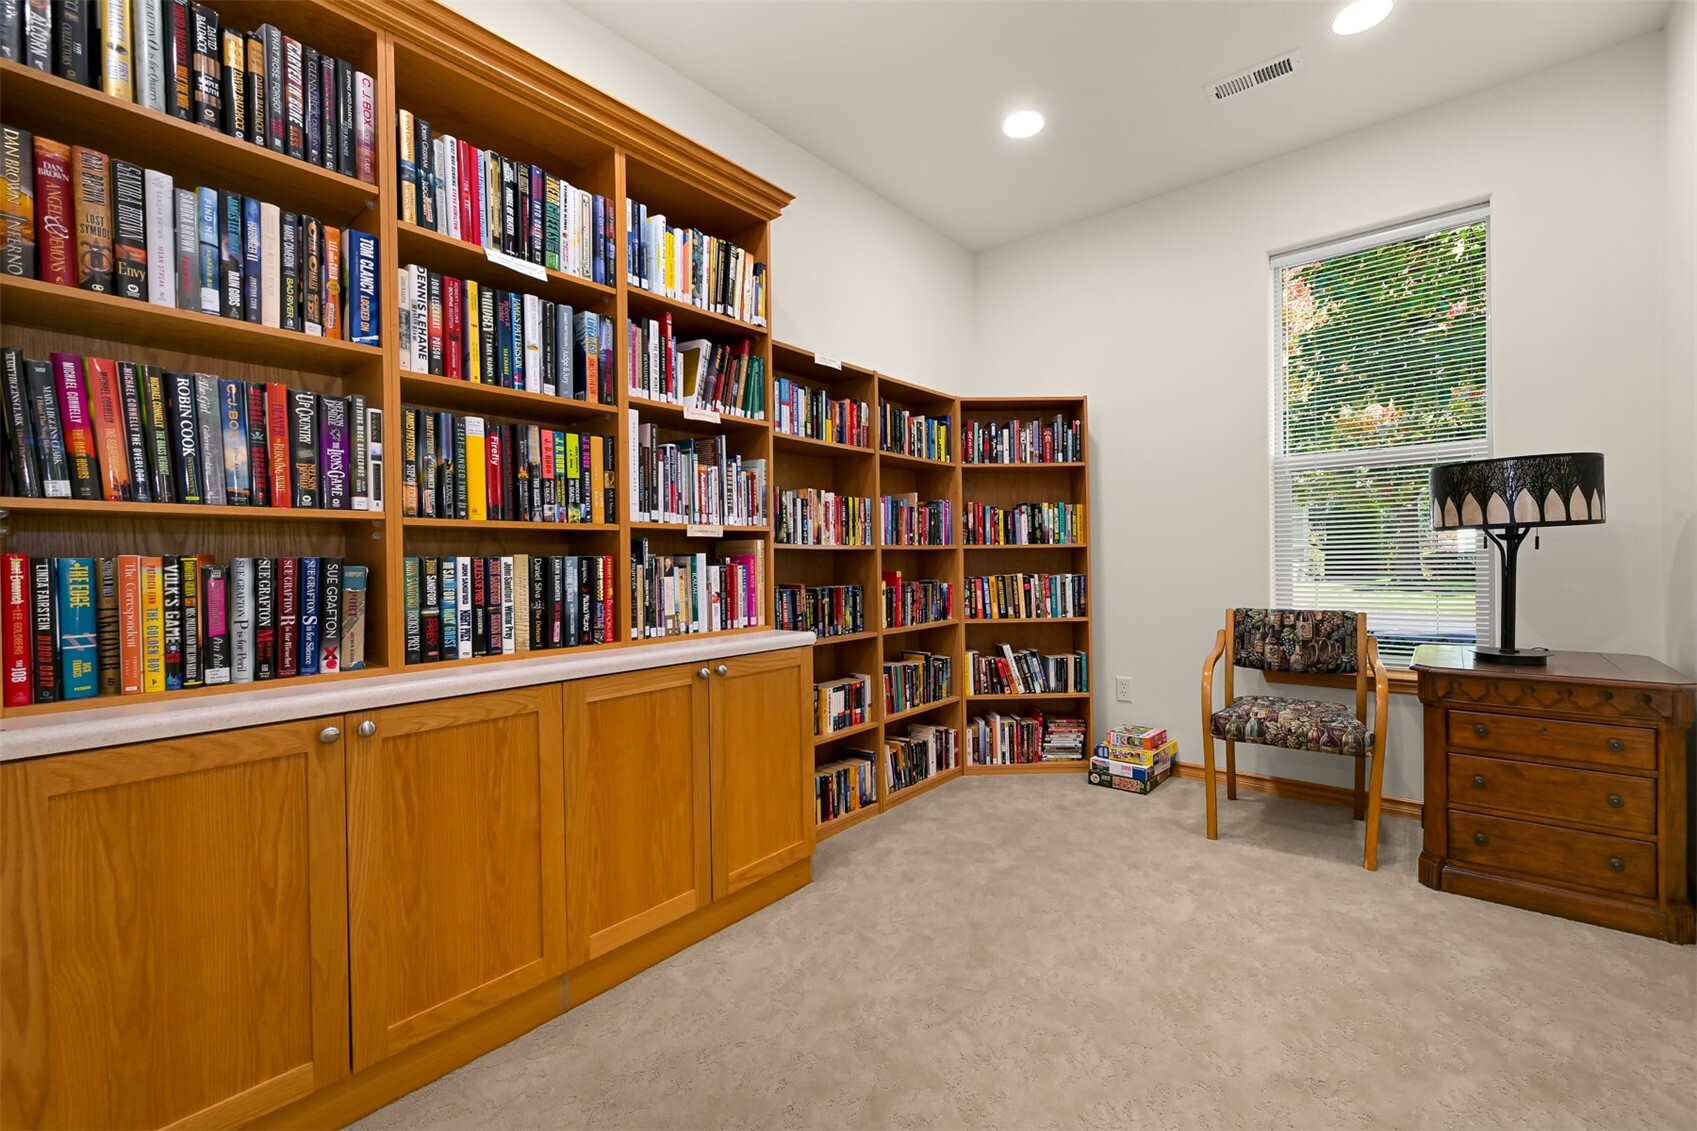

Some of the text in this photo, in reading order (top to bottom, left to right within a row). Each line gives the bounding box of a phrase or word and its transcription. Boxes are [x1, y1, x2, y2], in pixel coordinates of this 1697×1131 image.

[30, 11, 48, 58] ALCORN
[196, 14, 207, 53] BALDACCI
[207, 25, 217, 50] DAVID
[271, 30, 279, 57] WHAT
[255, 75, 263, 98] DAVID
[272, 58, 280, 79] ROSE
[287, 43, 303, 127] CARVED IN BONE
[233, 70, 244, 130] DAVID BALDACCI
[272, 81, 281, 115] FORGOT
[308, 61, 318, 118] GLENN BECK
[362, 78, 371, 127] C. J. BOX
[254, 100, 264, 133] BALDACCI
[290, 126, 298, 147] BASS
[421, 124, 429, 141] JOHN
[3, 129, 21, 204] DAN BROWN
[38, 168, 69, 182] BROWN
[43, 161, 63, 172] DAN
[80, 152, 105, 206] DAN BROWN
[86, 214, 104, 226] LOST
[117, 164, 143, 243] SANDRA BROWN
[180, 193, 194, 253] SANDRA BROWN
[204, 198, 212, 239] FIND ME
[1, 213, 27, 275] INFERNO
[80, 224, 111, 240] SYMBOL
[284, 225, 294, 268] MARC CAMERON
[534, 219, 542, 250] OBLIVION
[118, 262, 146, 282] Envy
[360, 238, 374, 295] TOM CLANCY
[228, 271, 240, 306] RAIN GODS
[286, 278, 294, 318] BAD RIVER
[360, 295, 370, 332] LOCKED ON
[417, 267, 427, 360] DENNIS LEHANE
[481, 291, 494, 334] WHIDBEY
[512, 298, 523, 368] JAMES PATTERSON
[432, 337, 440, 360] POISON
[62, 362, 82, 423] MICHAEL CONNELLY
[123, 368, 139, 432] MICHAEL CONNELLY
[150, 377, 164, 428] MICHAEL CONNELLY
[177, 378, 195, 456] ROBIN COOK
[334, 401, 344, 427] NELSON
[405, 411, 416, 461] JAMES PATTERSON
[457, 429, 466, 478] LEFT-HANDED
[490, 436, 499, 466] Firefly
[131, 434, 145, 482] THE OVERLOOK
[307, 464, 316, 490] NELSON
[69, 566, 90, 608] THE EDGE
[164, 565, 180, 607] VOLK'S
[283, 560, 292, 575] SUE
[306, 560, 316, 575] SUE
[405, 561, 418, 608] JOHN SANDFORD
[426, 560, 436, 605] JOHN SANDFORD
[474, 559, 484, 606] RULES OF PREY
[490, 560, 500, 605] JOHN SANDFORD
[504, 562, 512, 603] John Sandford
[35, 564, 50, 630] LINDA FAIRSTEIN
[123, 563, 138, 648] The Correspondent
[258, 560, 271, 626] SUE GRAFTON
[283, 577, 292, 613] GRAFTON
[306, 576, 316, 614] GRAFTON
[326, 564, 338, 638] SUE GRAFTON
[12, 609, 23, 655] LEE GOLDBERG
[165, 611, 181, 644] GAME
[234, 560, 249, 672] SUE GRAFTON P is for Peril
[280, 615, 295, 626] R
[302, 616, 318, 626] S
[306, 632, 315, 641] for
[408, 610, 419, 651] BROKEN PREY
[503, 606, 513, 640] Winter Prey
[146, 608, 160, 673] THE GOLDEN BOY
[285, 642, 293, 668] Ricochet
[305, 642, 315, 664] Silence
[11, 667, 26, 683] JOB
[38, 636, 54, 687] BLOOD OATH
